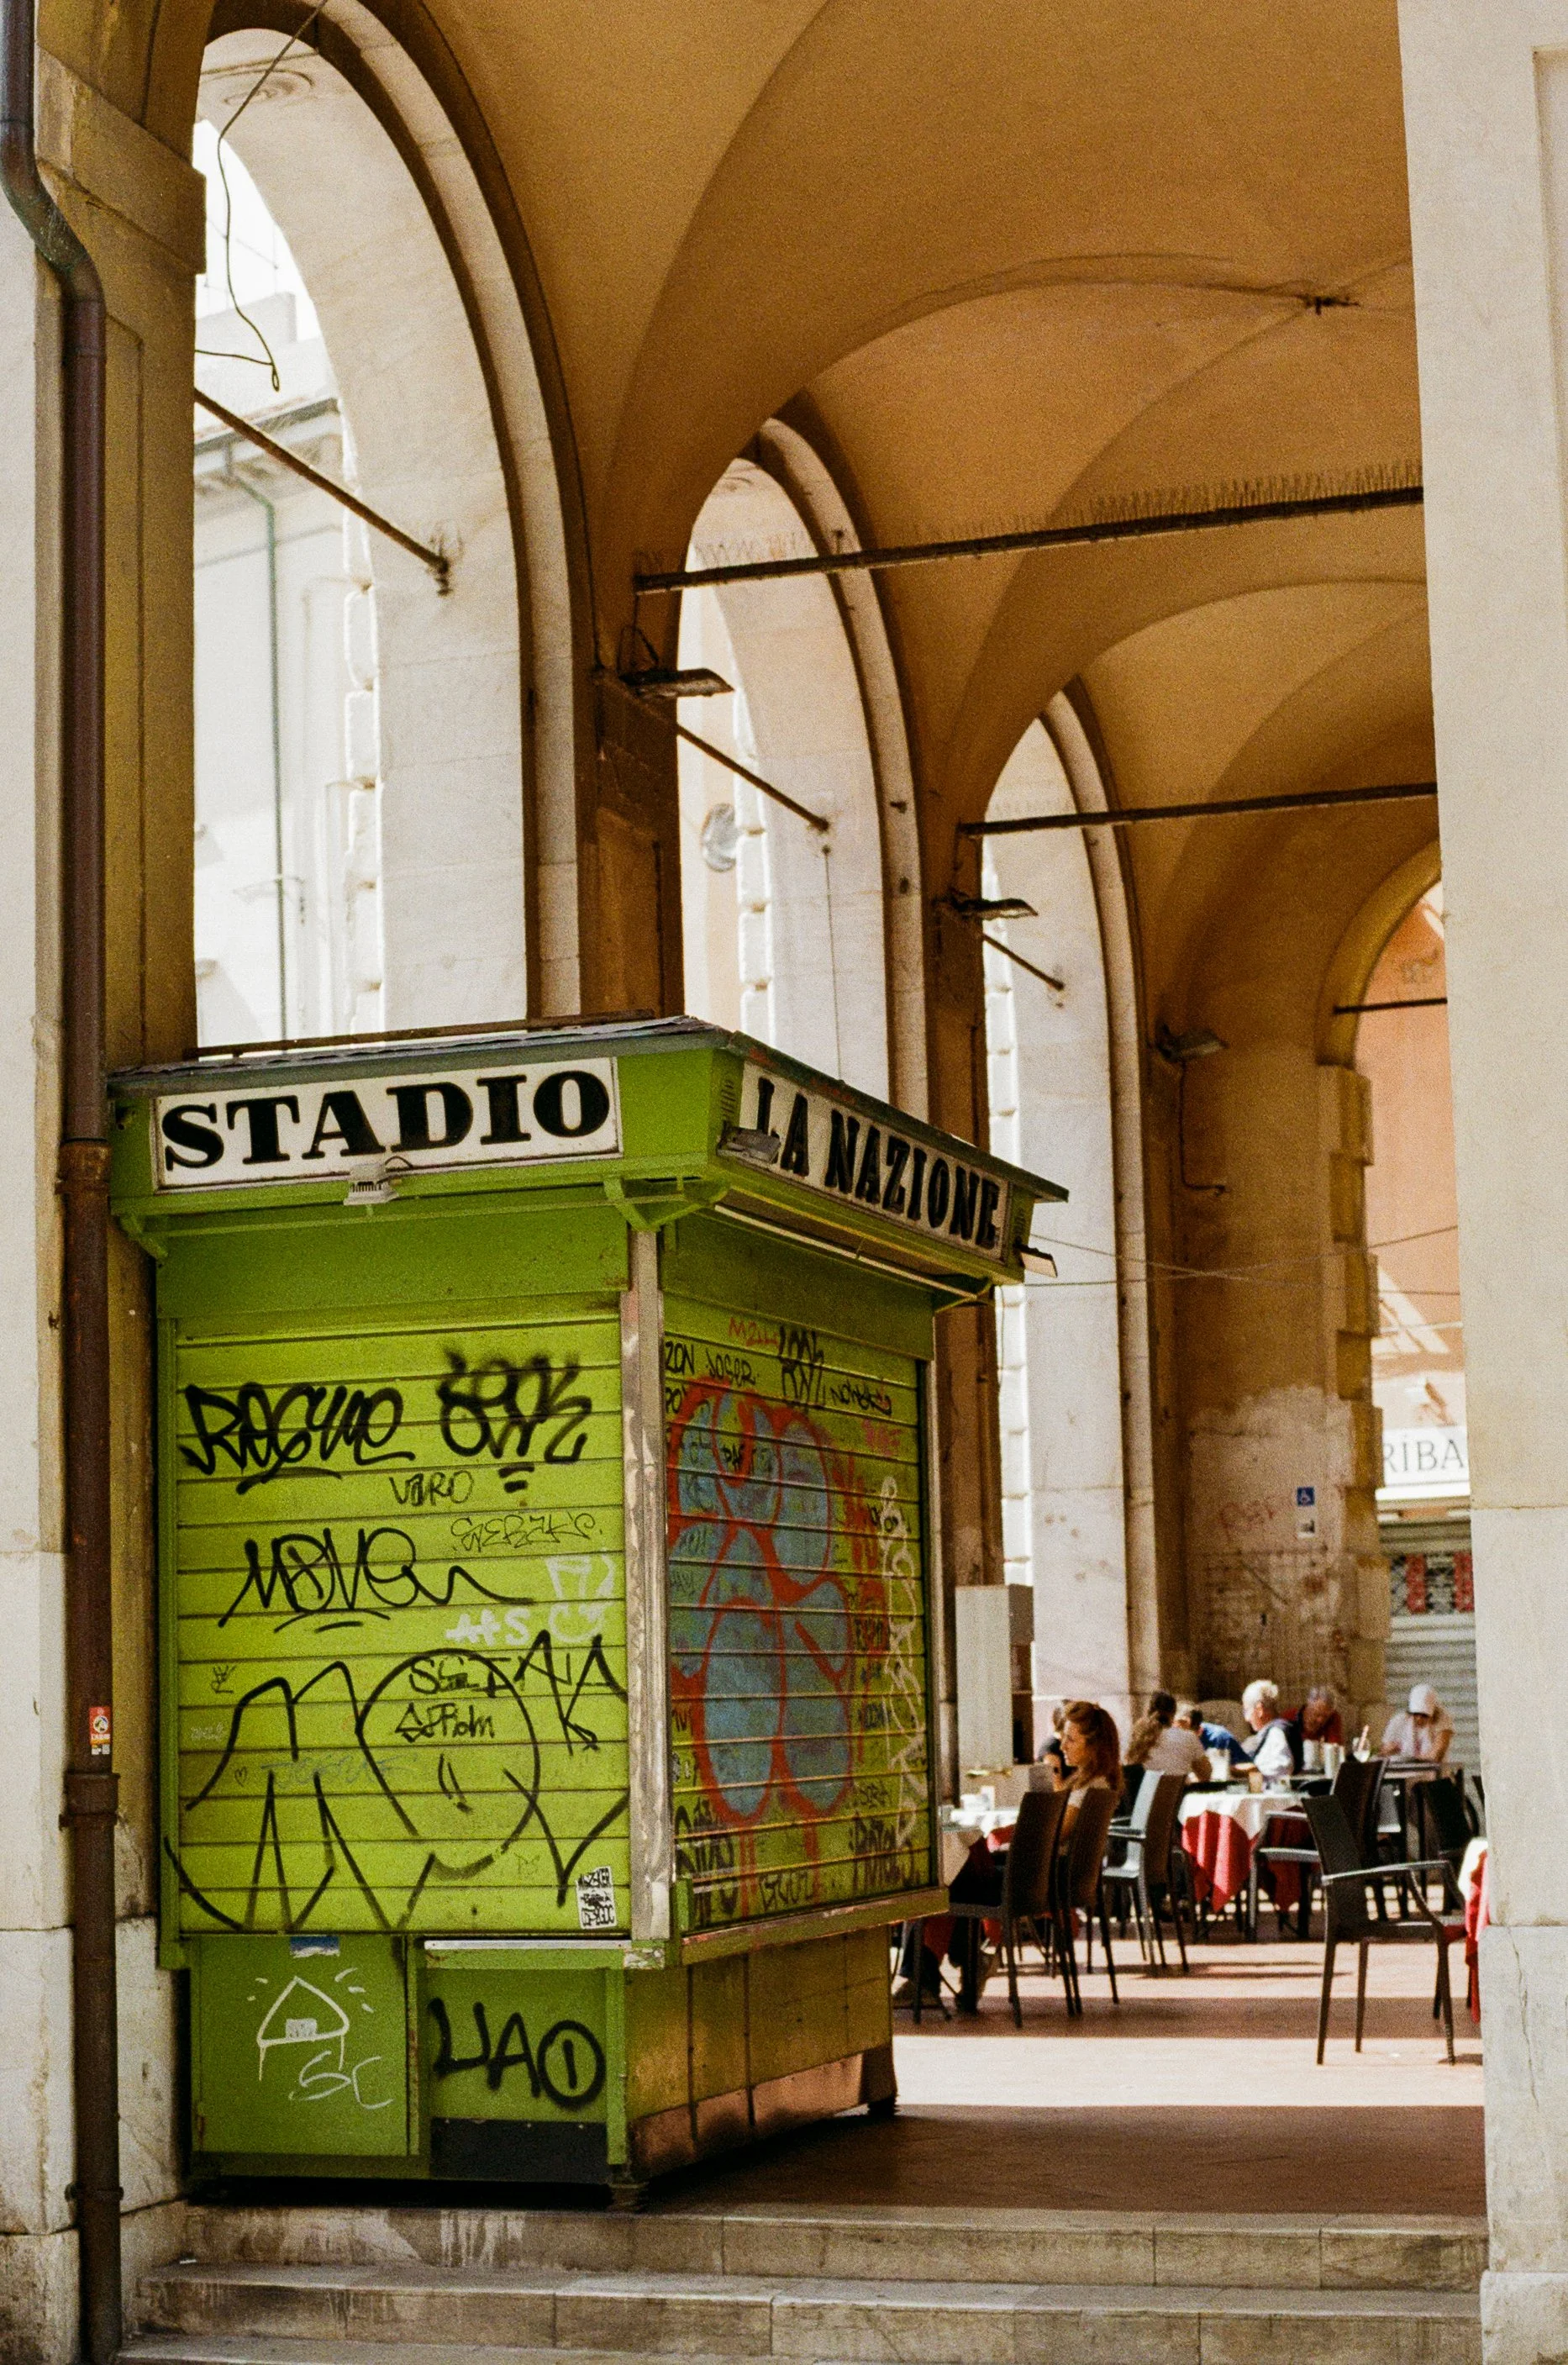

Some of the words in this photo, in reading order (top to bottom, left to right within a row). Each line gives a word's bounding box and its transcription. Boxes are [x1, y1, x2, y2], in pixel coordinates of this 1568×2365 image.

[161, 1069, 610, 1172] STADIO
[757, 1077, 810, 1177] LA
[823, 1108, 1001, 1251] NAZIONE
